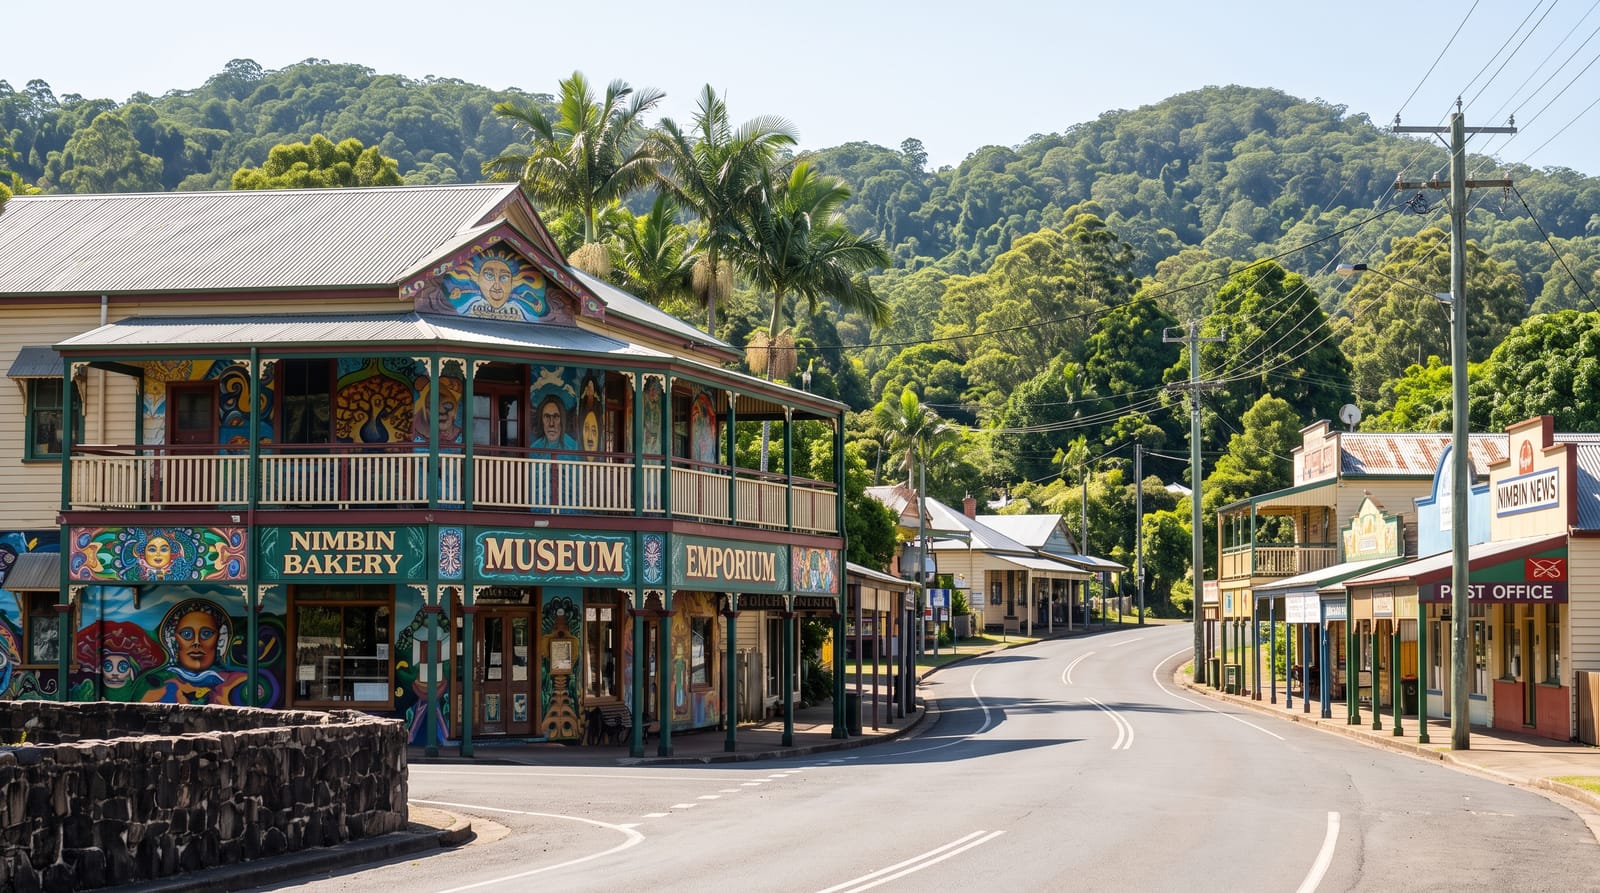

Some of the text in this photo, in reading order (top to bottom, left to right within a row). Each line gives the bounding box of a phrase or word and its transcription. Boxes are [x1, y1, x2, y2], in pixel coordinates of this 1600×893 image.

[1498, 476, 1556, 508] NIMBIN NEWS
[289, 530, 396, 551] NIMBIN
[283, 554, 403, 575] BAKERY
[485, 537, 625, 574] MUSEUM
[685, 544, 777, 583] EMPORIUM
[1440, 584, 1553, 599] PST OFFICE
